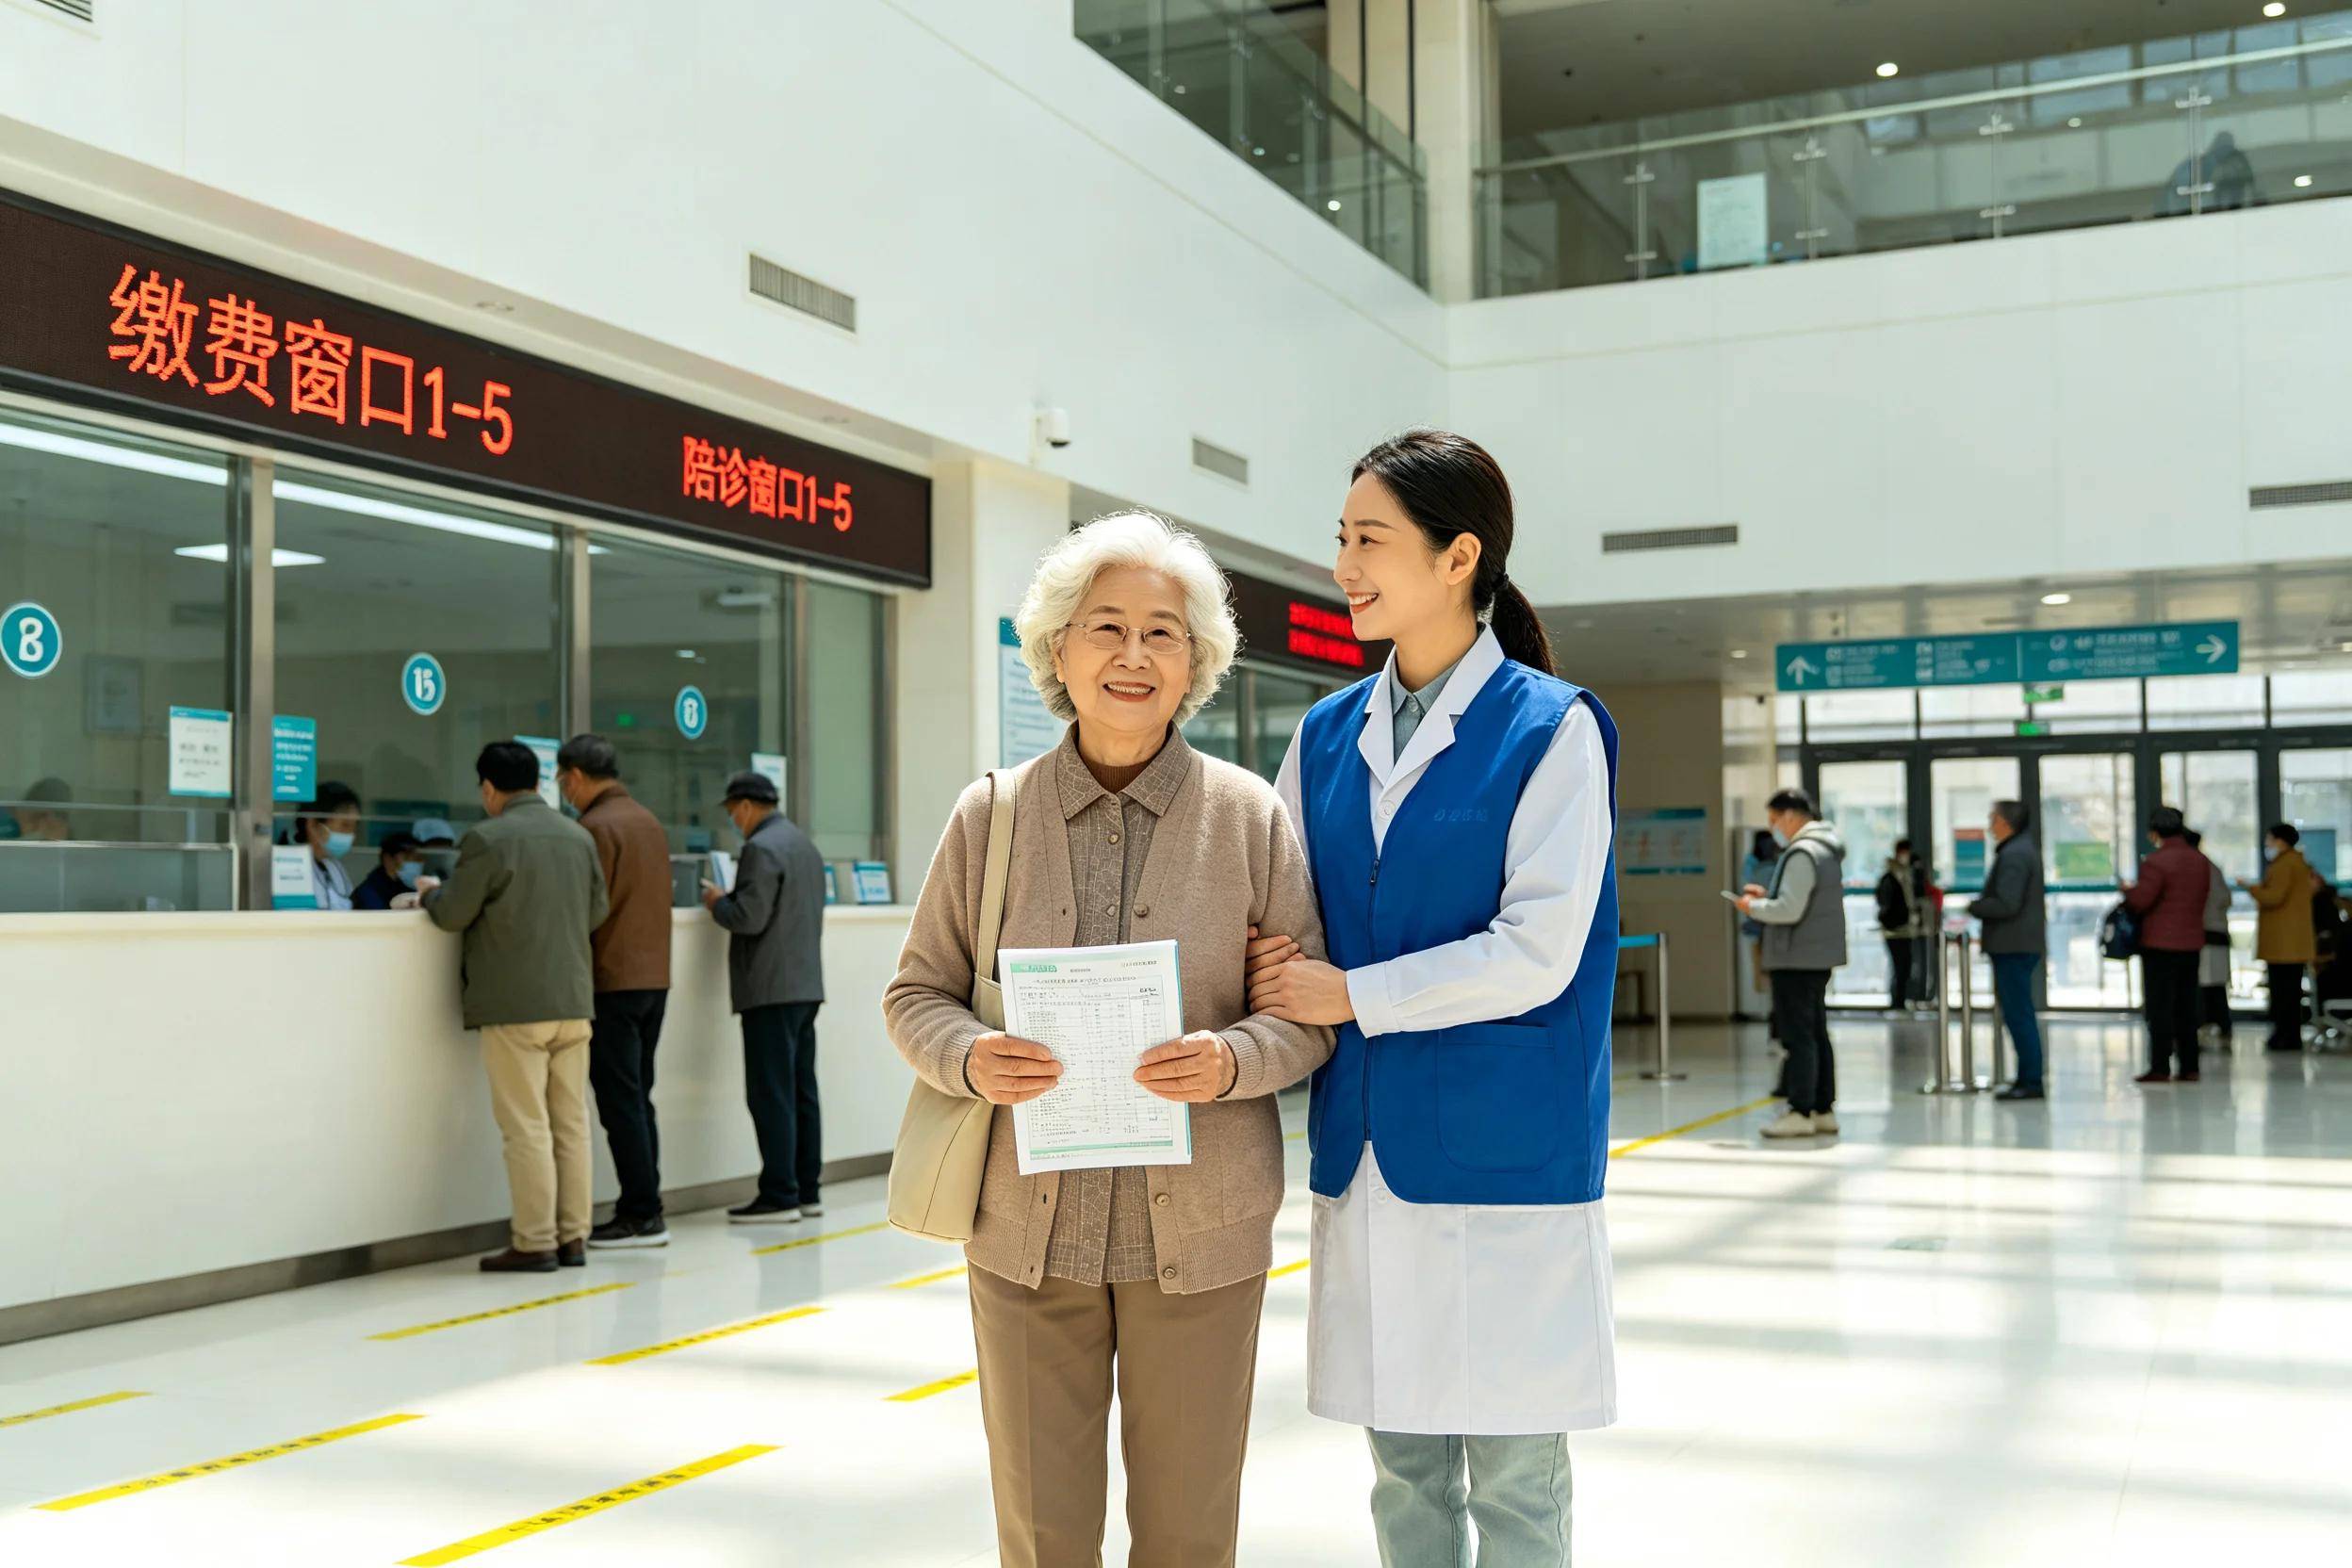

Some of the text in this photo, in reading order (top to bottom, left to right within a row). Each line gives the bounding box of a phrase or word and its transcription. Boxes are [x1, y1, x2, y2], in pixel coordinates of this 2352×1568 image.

[108, 263, 513, 455] 缴费窗口1-5
[682, 435, 853, 531] 陪诊窗口1-5
